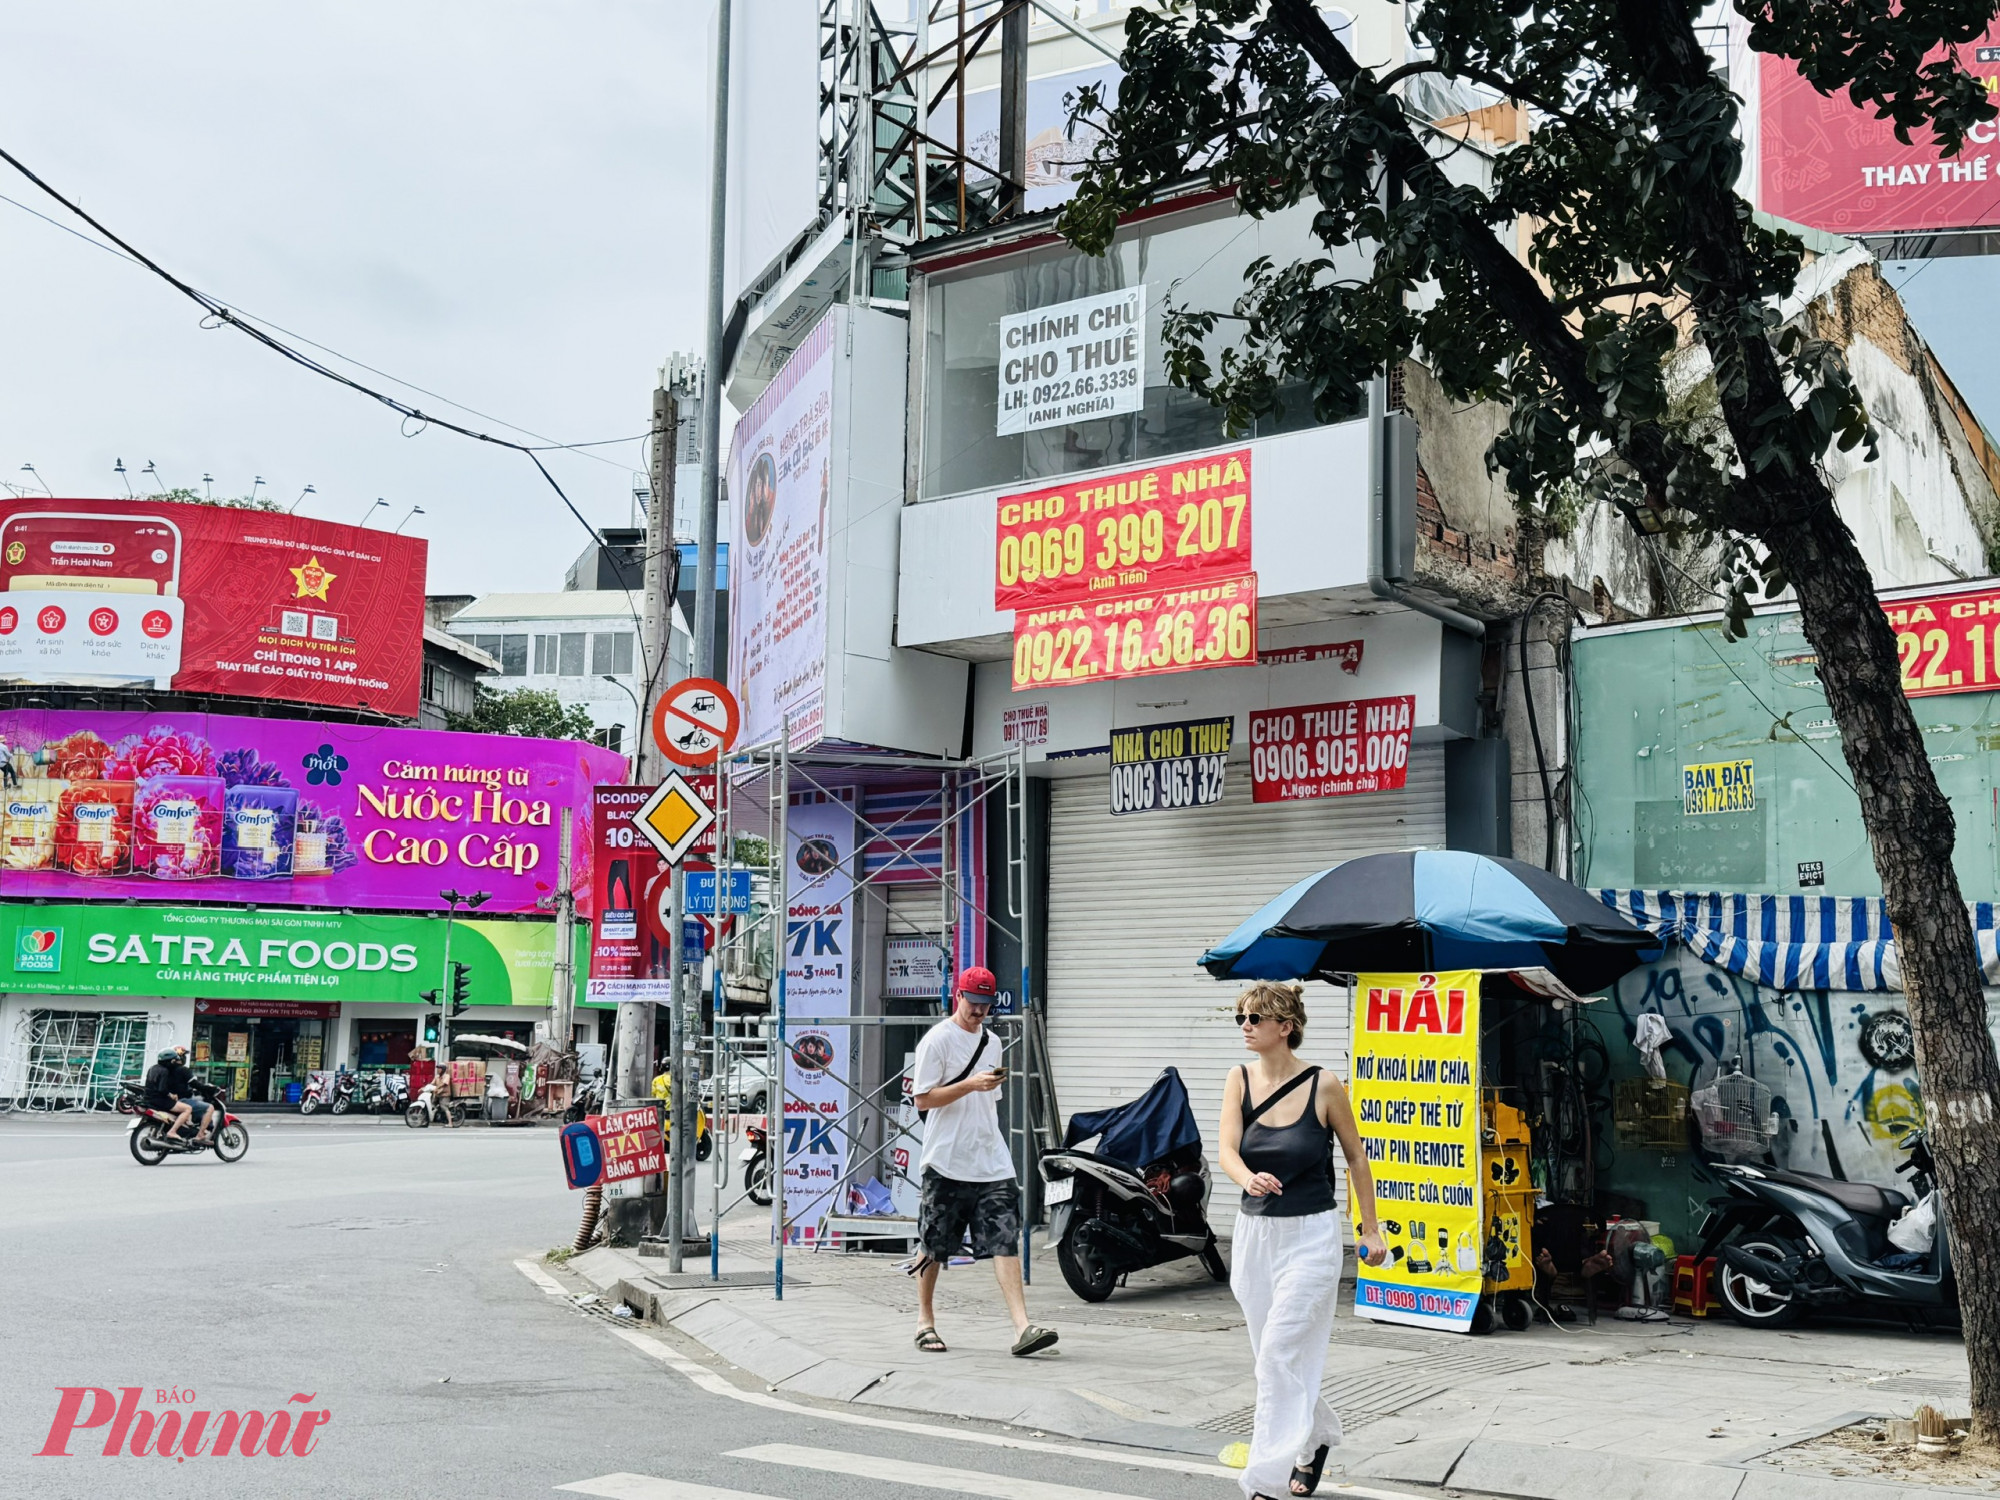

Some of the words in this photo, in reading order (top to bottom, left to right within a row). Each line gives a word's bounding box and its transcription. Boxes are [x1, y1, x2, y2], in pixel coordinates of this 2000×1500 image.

[1861, 164, 1931, 187] THAY
[1938, 153, 1991, 182] THẾ
[1006, 316, 1079, 349] CHÍNH
[1089, 293, 1139, 331] CHỦ
[1005, 351, 1058, 385] CHO
[1067, 328, 1138, 373] THUÊ
[1005, 390, 1028, 411] LH:
[1033, 368, 1137, 405] 0922.66.3339
[1029, 407, 1061, 424] (ANH
[1067, 396, 1114, 416] NGHĨA)
[1001, 496, 1064, 526] CHO
[1076, 473, 1159, 512] THUÊ
[1172, 457, 1246, 496] NHÀ
[244, 536, 267, 544] TRUNG
[269, 538, 284, 546] TÂM
[311, 544, 332, 553] QUỐC
[334, 548, 345, 556] GIA
[999, 524, 1084, 586] 0969
[1097, 510, 1163, 569] 399
[1176, 494, 1246, 557] 207
[1089, 577, 1115, 591] (Anh
[1119, 570, 1147, 585] Tiến)
[1029, 605, 1085, 627] NHÀ
[1096, 598, 1152, 617] CHO
[1164, 582, 1238, 605] THUÊ
[1885, 605, 1936, 625] HÀ
[1951, 599, 2000, 618] CH
[258, 635, 277, 644] MỌI
[280, 639, 303, 648] DỊCH
[306, 641, 317, 650] VỤ
[319, 643, 337, 653] TIỆN
[340, 643, 356, 655] ÍCH
[1014, 603, 1250, 684] 0922.16.36.36
[1896, 623, 2000, 690] 22.1
[216, 661, 240, 671] THAY
[242, 660, 260, 672] THẾ
[262, 662, 284, 675] CÁC
[286, 667, 310, 678] GIẤY
[310, 671, 323, 680] TỜ
[324, 672, 356, 685] TRUYỀN
[358, 676, 388, 690] THỐNG
[254, 650, 277, 660] CHỈ
[280, 653, 321, 667] TRONG
[325, 658, 330, 668] 1
[334, 659, 357, 672] APP
[1004, 711, 1016, 722] CHO
[1018, 706, 1033, 720] THUÊ
[1252, 715, 1294, 744] CHO
[1302, 702, 1357, 738] THUÊ
[1366, 697, 1410, 733] NHÀ
[1113, 728, 1144, 763] NHÀ
[1150, 721, 1183, 759] CHO
[1189, 718, 1230, 754] THUÊ
[309, 755, 338, 772] mới
[1253, 733, 1408, 783] 0906.905.006
[383, 760, 437, 781] Cảm
[444, 764, 502, 791] hứng
[507, 766, 529, 786] từ
[1113, 762, 1155, 812] 0903
[1161, 759, 1193, 808] 963
[1281, 783, 1317, 798] A.Ngọc
[1321, 779, 1353, 796] (chính
[1356, 775, 1378, 791] chủ)
[1685, 765, 1715, 789] BÁN
[1722, 761, 1752, 786] ĐẤT
[9, 802, 47, 816] Comfort
[76, 806, 116, 819] Comfort
[153, 804, 199, 819] Comfort
[355, 784, 463, 821] Nước
[472, 791, 550, 826] Hoa
[1685, 785, 1753, 813] 0931.72.63.63
[235, 812, 278, 825] Comfort
[364, 828, 448, 866] Cao
[458, 832, 539, 875] Cấp
[1800, 863, 1821, 871] VEKS
[700, 878, 736, 888] ĐƯNG
[689, 892, 700, 908] LÝ
[702, 896, 714, 911] TỰ
[722, 896, 746, 908] RNG
[788, 903, 820, 916] ĐỒNG
[163, 914, 184, 923] TỔNG
[186, 915, 208, 924] CÔNG
[210, 916, 218, 925] TY
[220, 916, 253, 926] THƯƠNG
[255, 918, 270, 927] MẠI
[271, 917, 283, 927] SÀI
[284, 917, 302, 927] GÒN
[303, 919, 324, 928] TNHH
[598, 946, 618, 956] 10%
[788, 920, 842, 956] 7K
[88, 933, 252, 968] SATRA
[258, 939, 418, 972] FOODS
[157, 969, 180, 980] CỬA
[183, 970, 220, 982] HÀNG
[224, 971, 255, 984] THỰC
[257, 970, 291, 984] PHẨM
[293, 974, 319, 986] TIỆN
[321, 974, 339, 988] LỢI
[804, 965, 813, 980] 3
[815, 968, 835, 978] TẶNG
[836, 964, 842, 979] 1
[590, 982, 606, 995] 12
[1367, 974, 1465, 1034] HẢI
[1356, 1050, 1374, 1079] MỞ
[1377, 1054, 1407, 1081] KHOÁ
[1411, 1055, 1436, 1083] LÀM
[1441, 1056, 1470, 1085] CHÌA
[820, 1100, 839, 1113] GIÁ
[1360, 1099, 1381, 1122] SAO
[1386, 1097, 1416, 1124] CHÉP
[1420, 1095, 1441, 1127] THẺ
[1446, 1100, 1464, 1128] TỪ
[597, 1115, 624, 1135] LÀM
[626, 1109, 657, 1128] CHÌA
[602, 1128, 646, 1158] HẢI
[783, 1118, 838, 1155] 7K
[606, 1158, 635, 1178] BẰNG
[638, 1150, 659, 1171] MÁY
[1390, 1140, 1410, 1164] PIN
[1414, 1141, 1465, 1168] REMOTE
[799, 1164, 809, 1179] 3
[810, 1168, 831, 1178] TẶNG
[832, 1164, 839, 1180] 1
[1376, 1179, 1415, 1201] REMOTE
[1419, 1178, 1439, 1204] CỬA
[1443, 1180, 1473, 1206] CUỐN
[1366, 1286, 1383, 1303] ĐT:
[1386, 1289, 1416, 1309] 0908
[1420, 1294, 1451, 1314] 1014
[1454, 1299, 1470, 1316] 67
